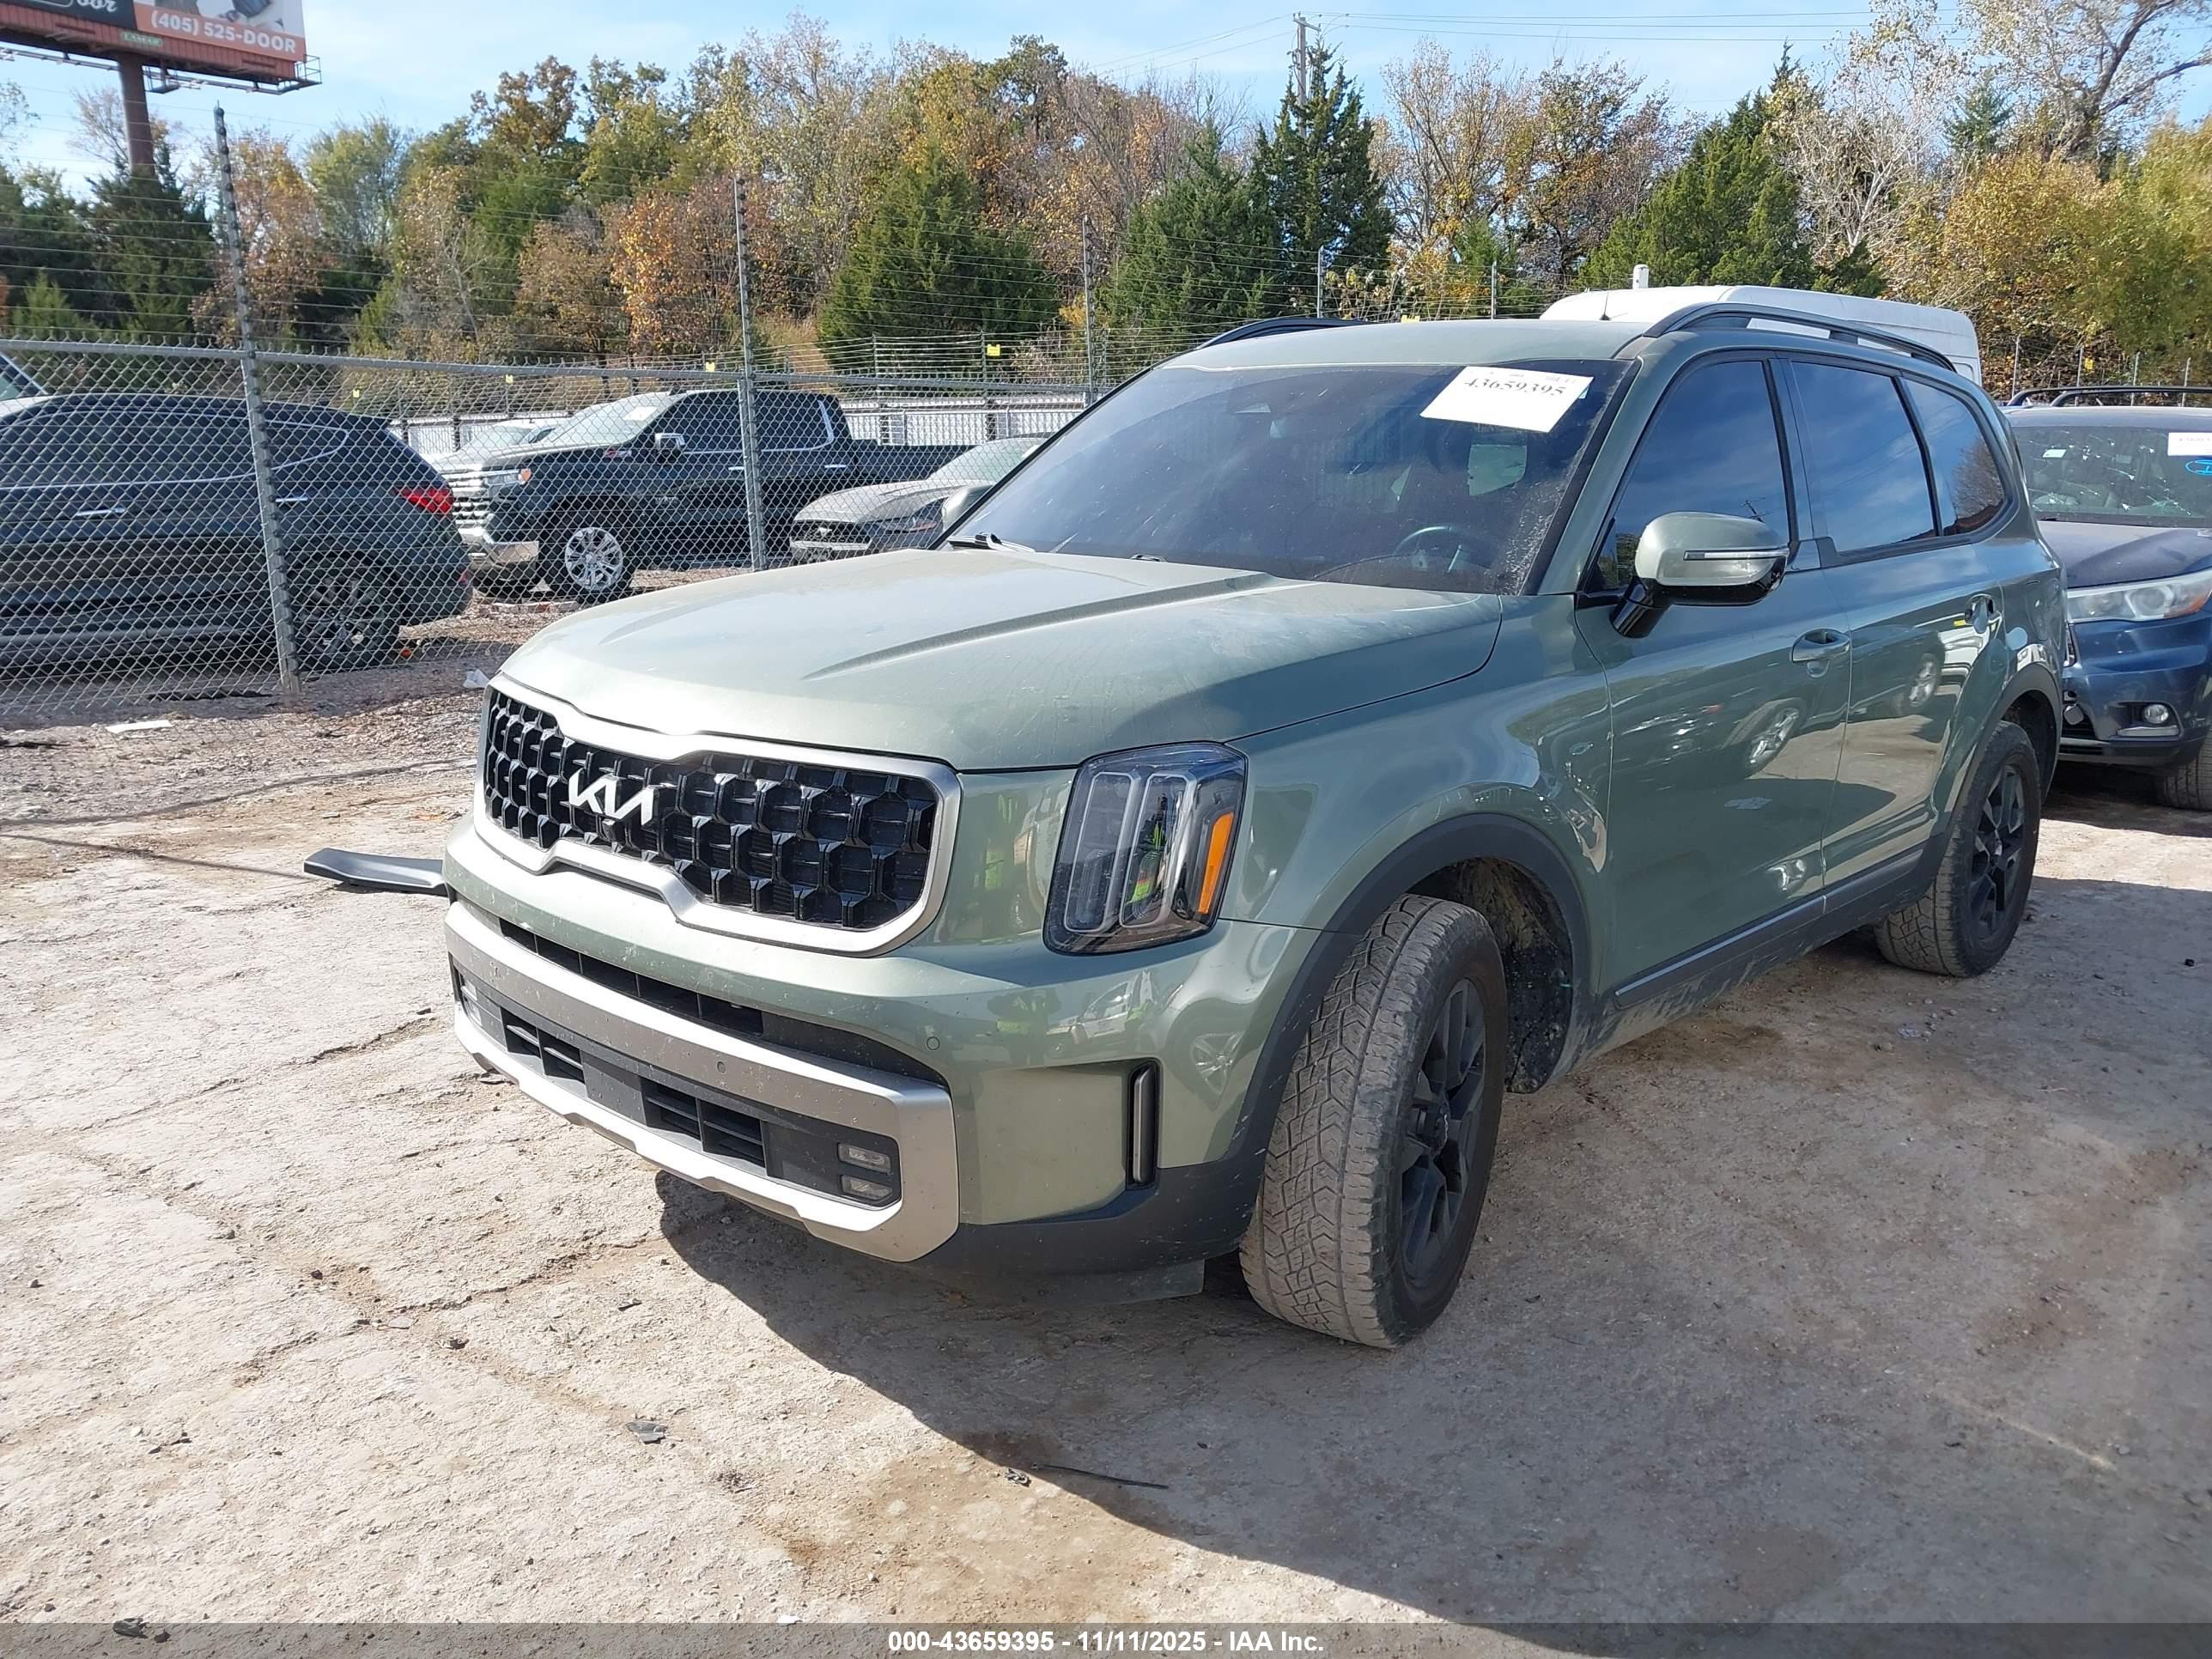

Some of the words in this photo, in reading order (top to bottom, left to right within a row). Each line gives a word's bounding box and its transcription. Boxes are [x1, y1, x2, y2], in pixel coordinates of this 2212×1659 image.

[151, 10, 199, 36] (405)
[204, 21, 296, 53] 525-DOOR
[1464, 378, 1566, 396] 43659395
